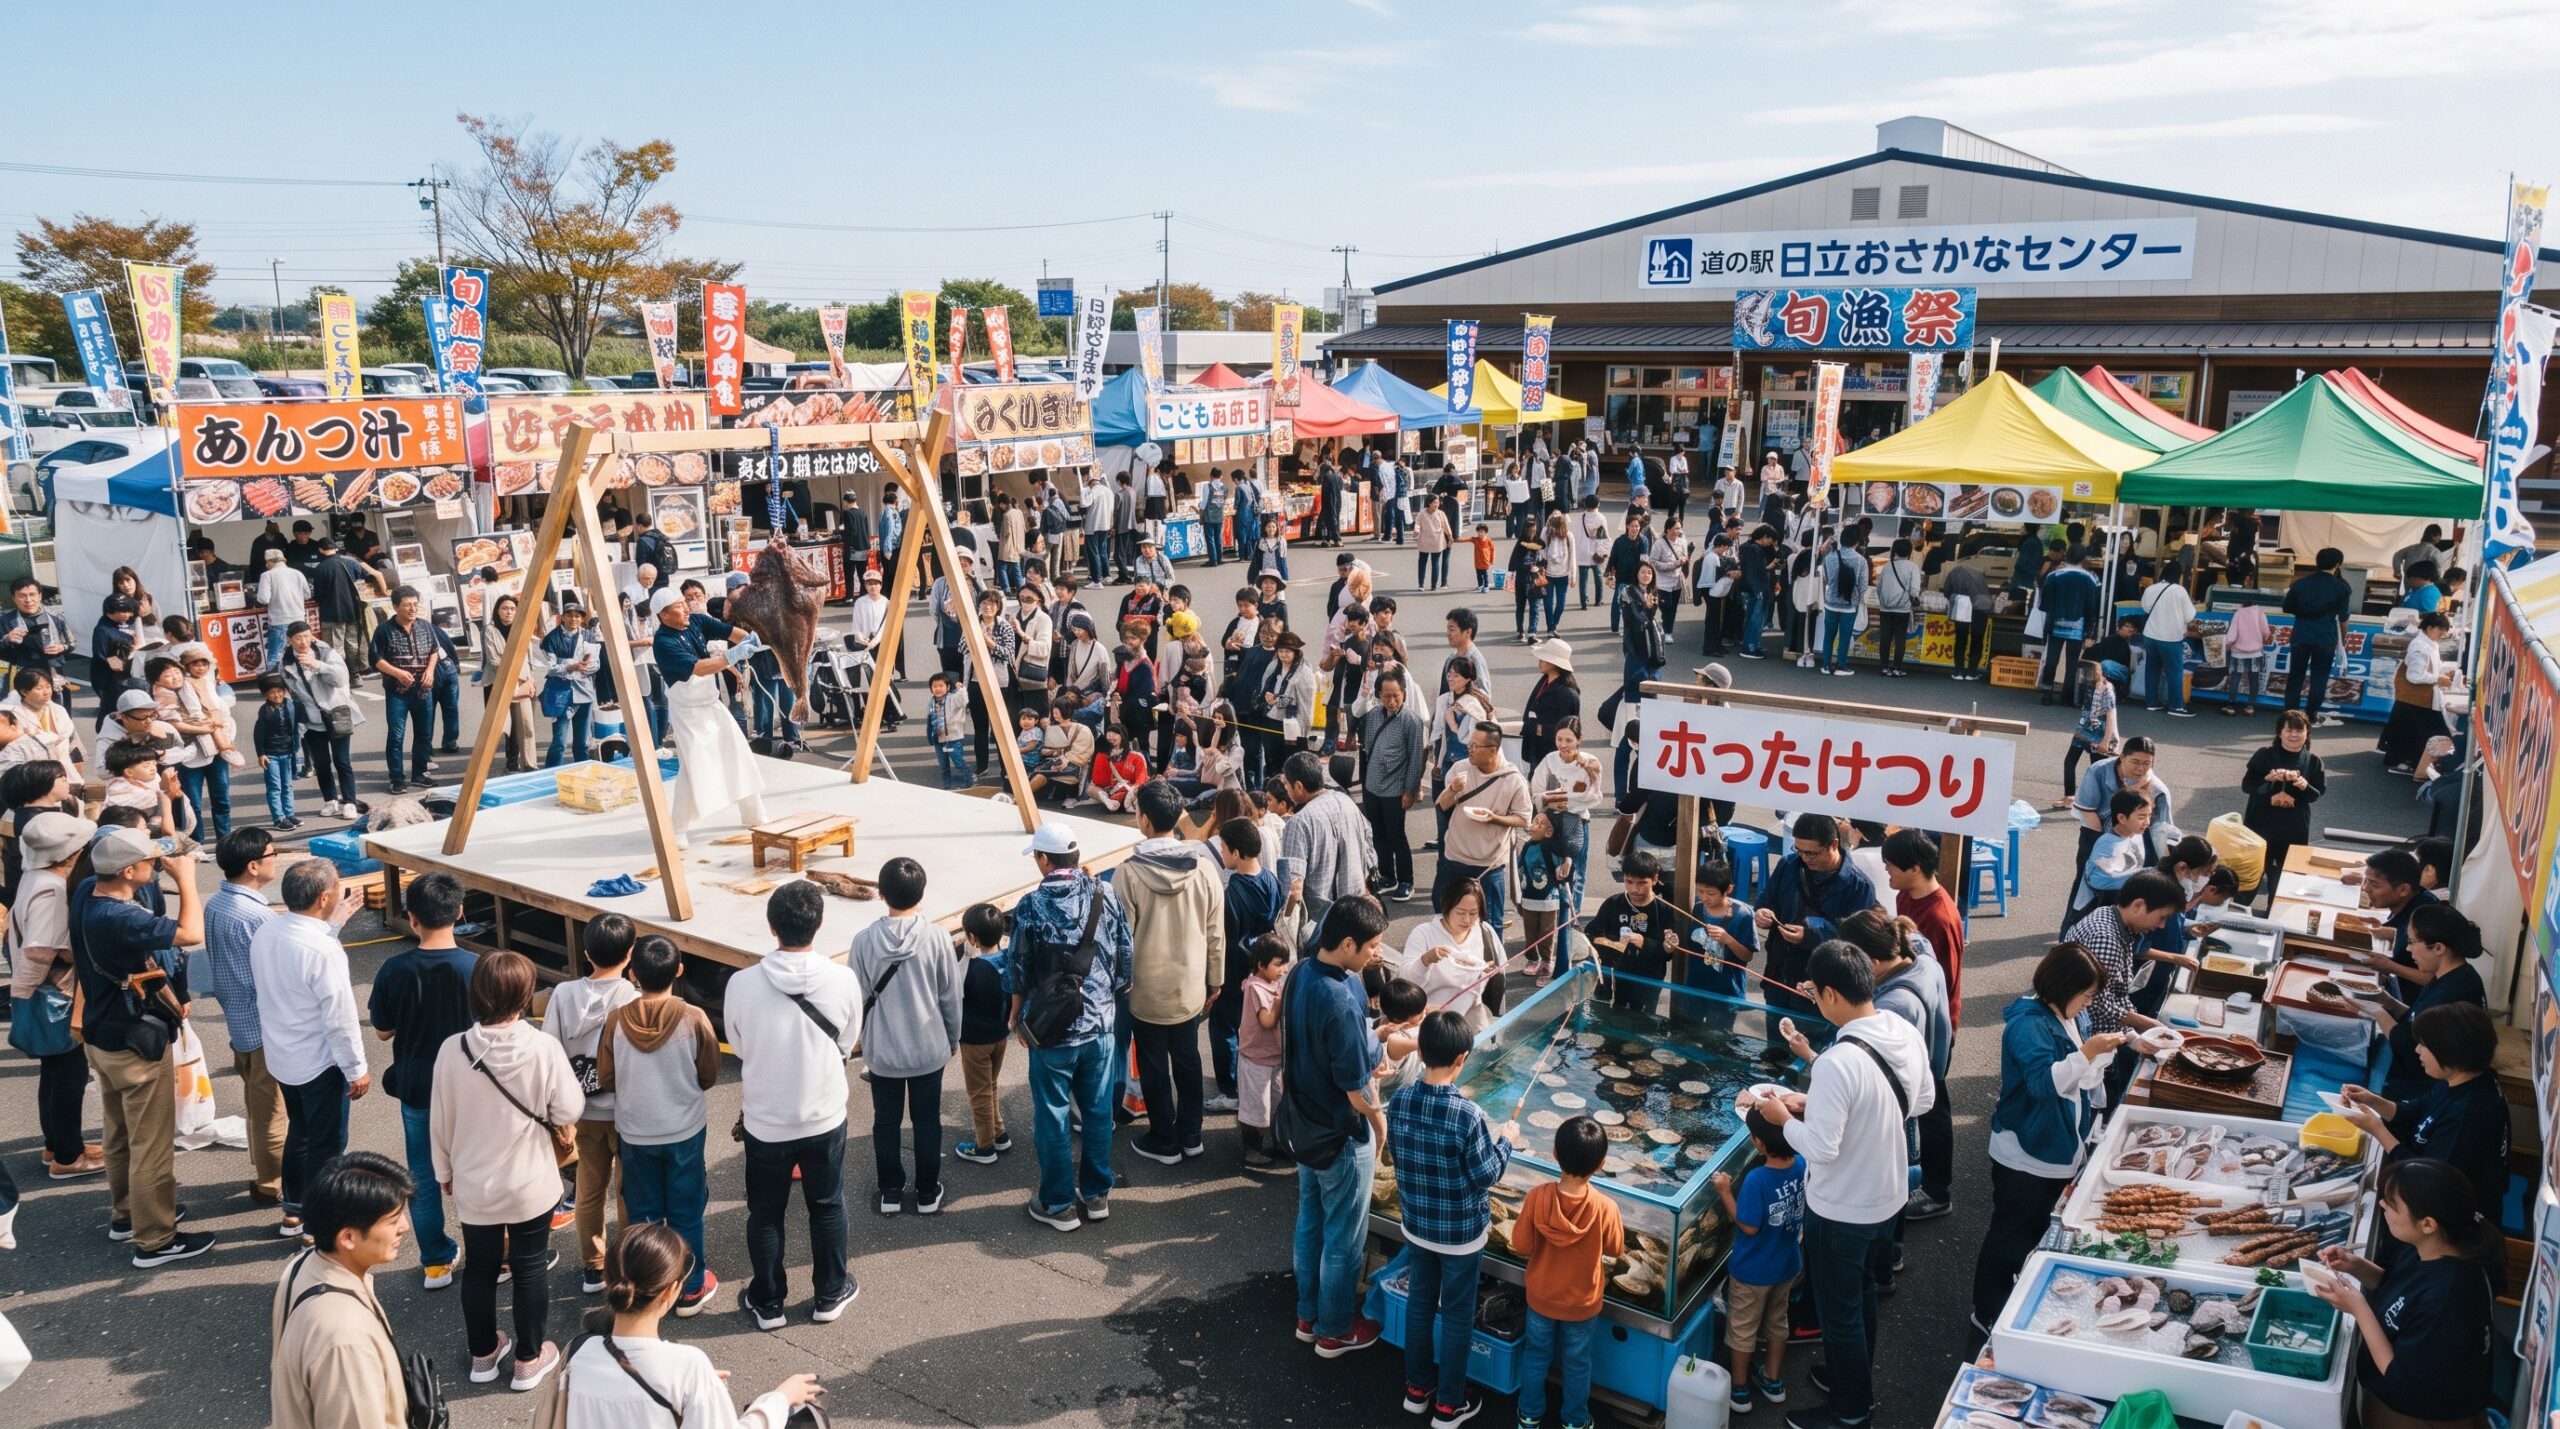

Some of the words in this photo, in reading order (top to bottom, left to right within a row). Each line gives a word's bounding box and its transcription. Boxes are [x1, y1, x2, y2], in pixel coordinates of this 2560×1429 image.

[1700, 248, 1774, 276] 道の駅
[1780, 232, 2183, 278] 日立おさかなセンター
[449, 270, 483, 373] 旬漁祭
[1778, 288, 1964, 347] 旬漁祭
[196, 407, 412, 466] あんつ汁
[1656, 720, 1986, 819] ホったけつり
